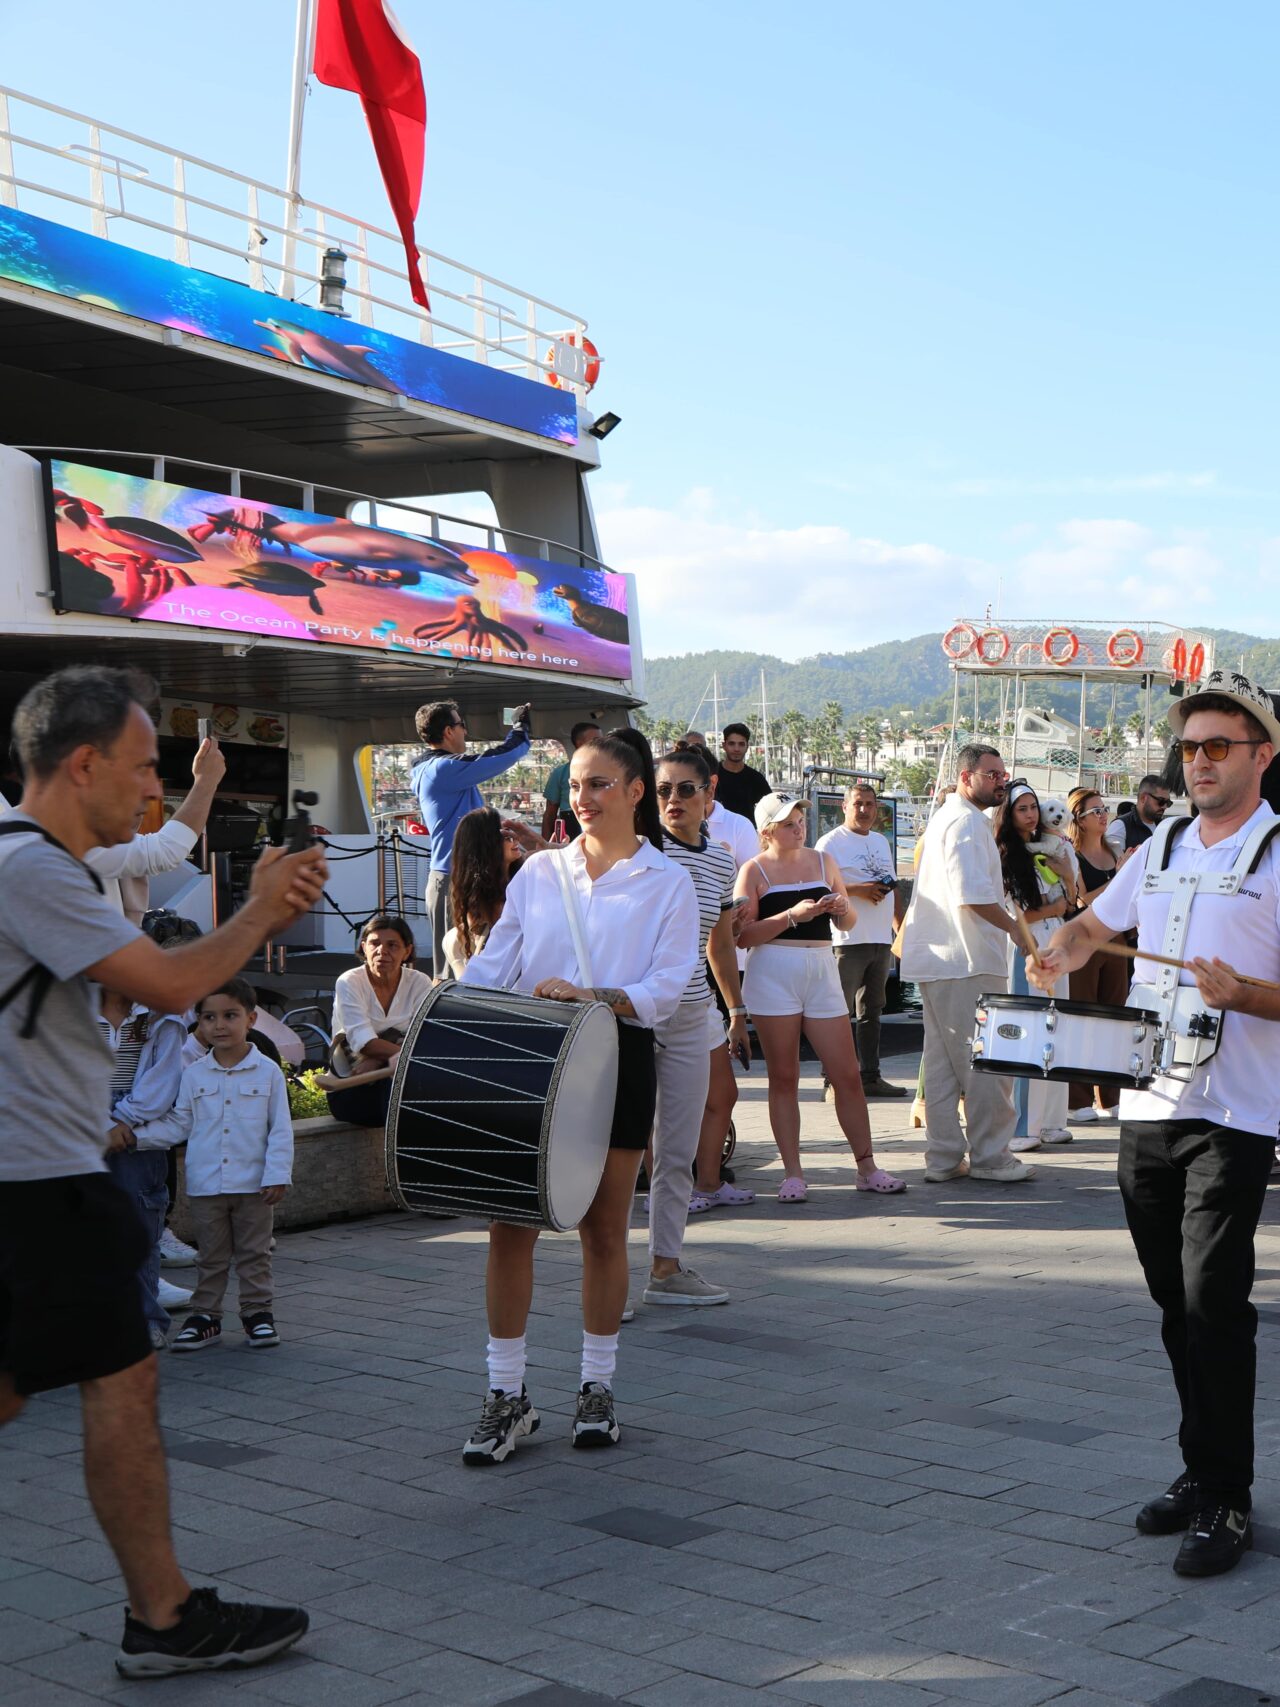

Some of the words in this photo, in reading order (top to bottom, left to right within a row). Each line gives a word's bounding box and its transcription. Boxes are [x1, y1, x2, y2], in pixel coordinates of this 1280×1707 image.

[165, 602, 211, 618] The
[220, 610, 296, 629] Ocean
[304, 621, 362, 639] Party
[370, 632, 385, 641] is
[392, 633, 492, 656] happening
[498, 646, 536, 661] here
[543, 653, 579, 667] here
